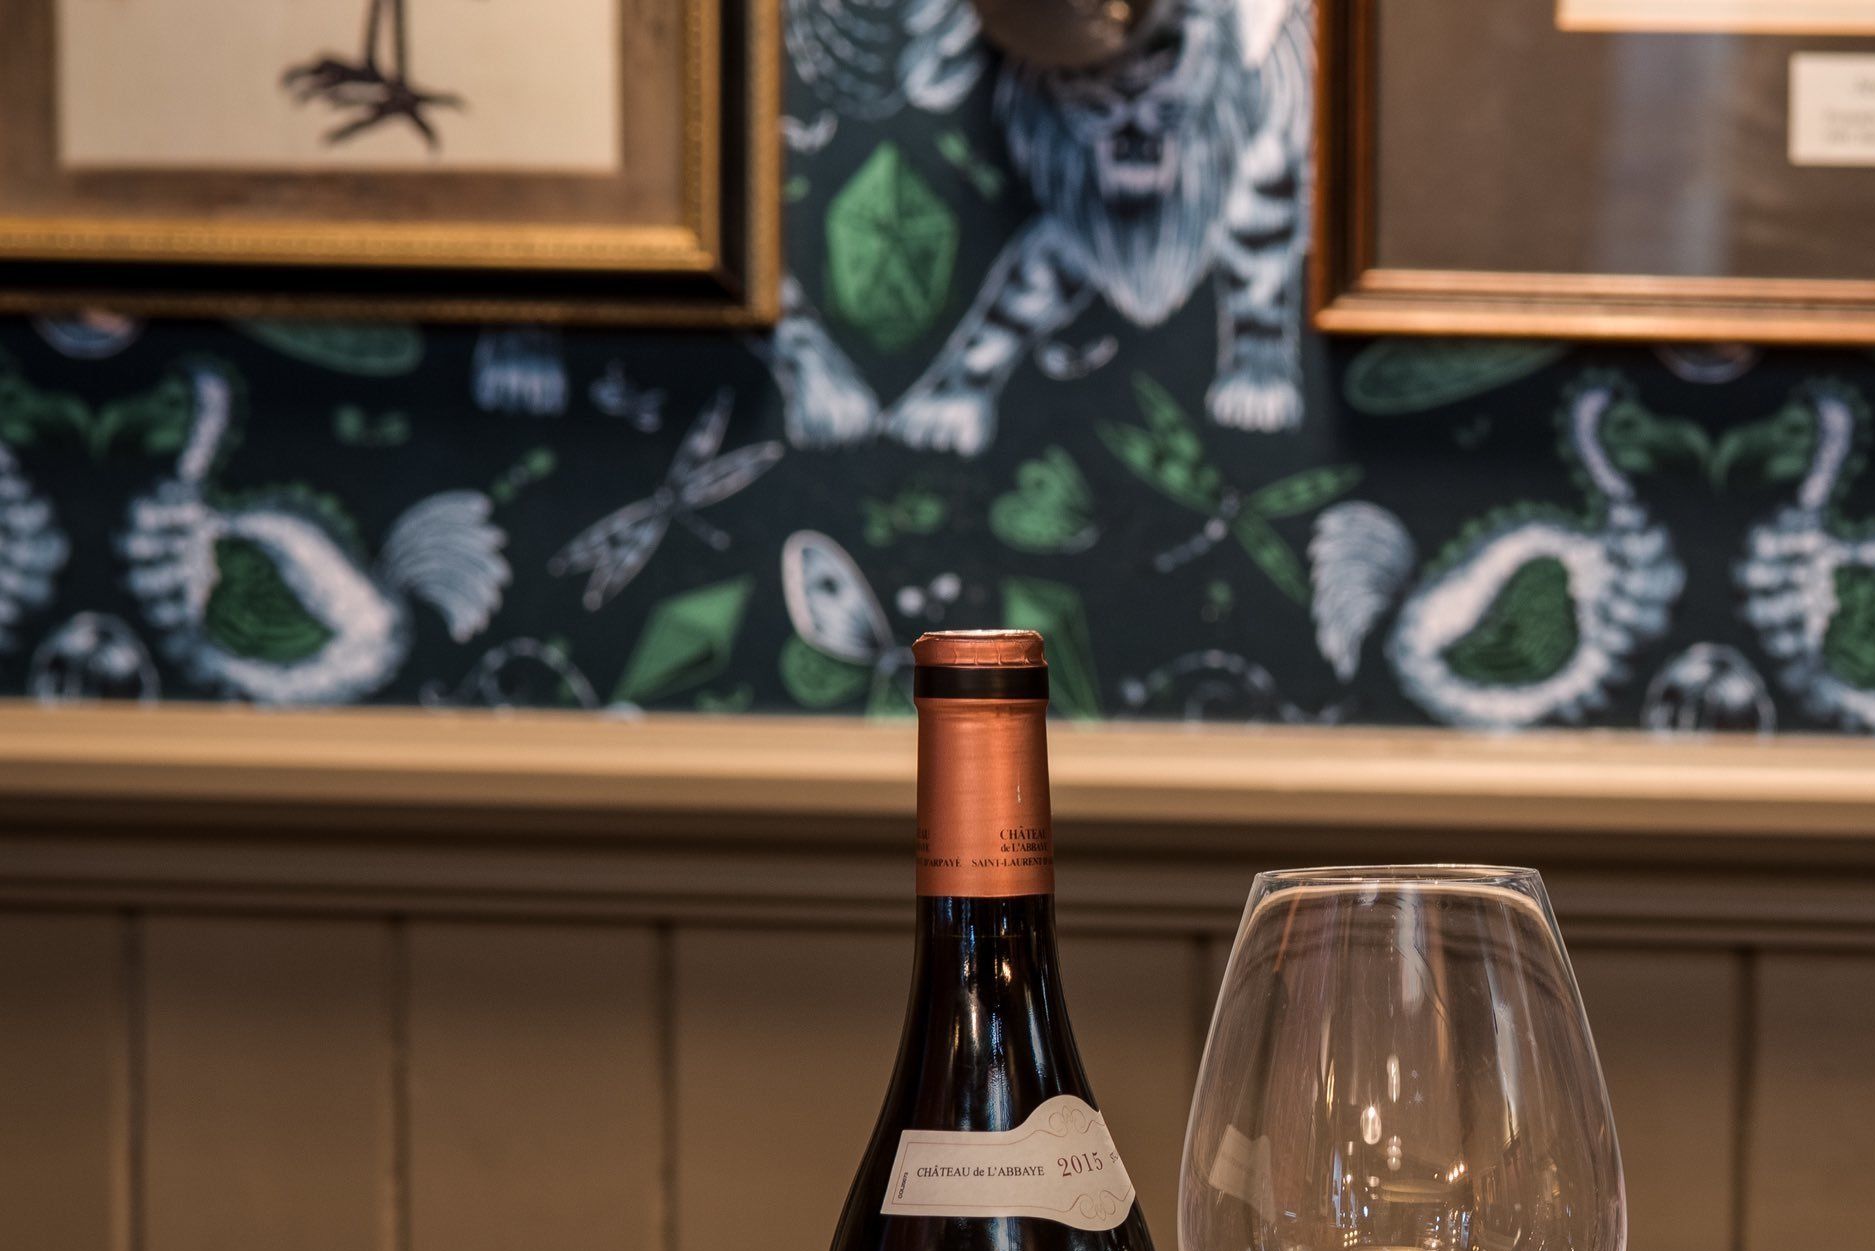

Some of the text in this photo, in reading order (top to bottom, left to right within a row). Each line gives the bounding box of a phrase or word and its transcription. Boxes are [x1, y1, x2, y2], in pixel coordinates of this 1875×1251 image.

[1001, 843, 1010, 852] de
[1057, 1152, 1103, 1177] 2015
[917, 1165, 1044, 1177] CHÂTEAU de L'ABBAYE
